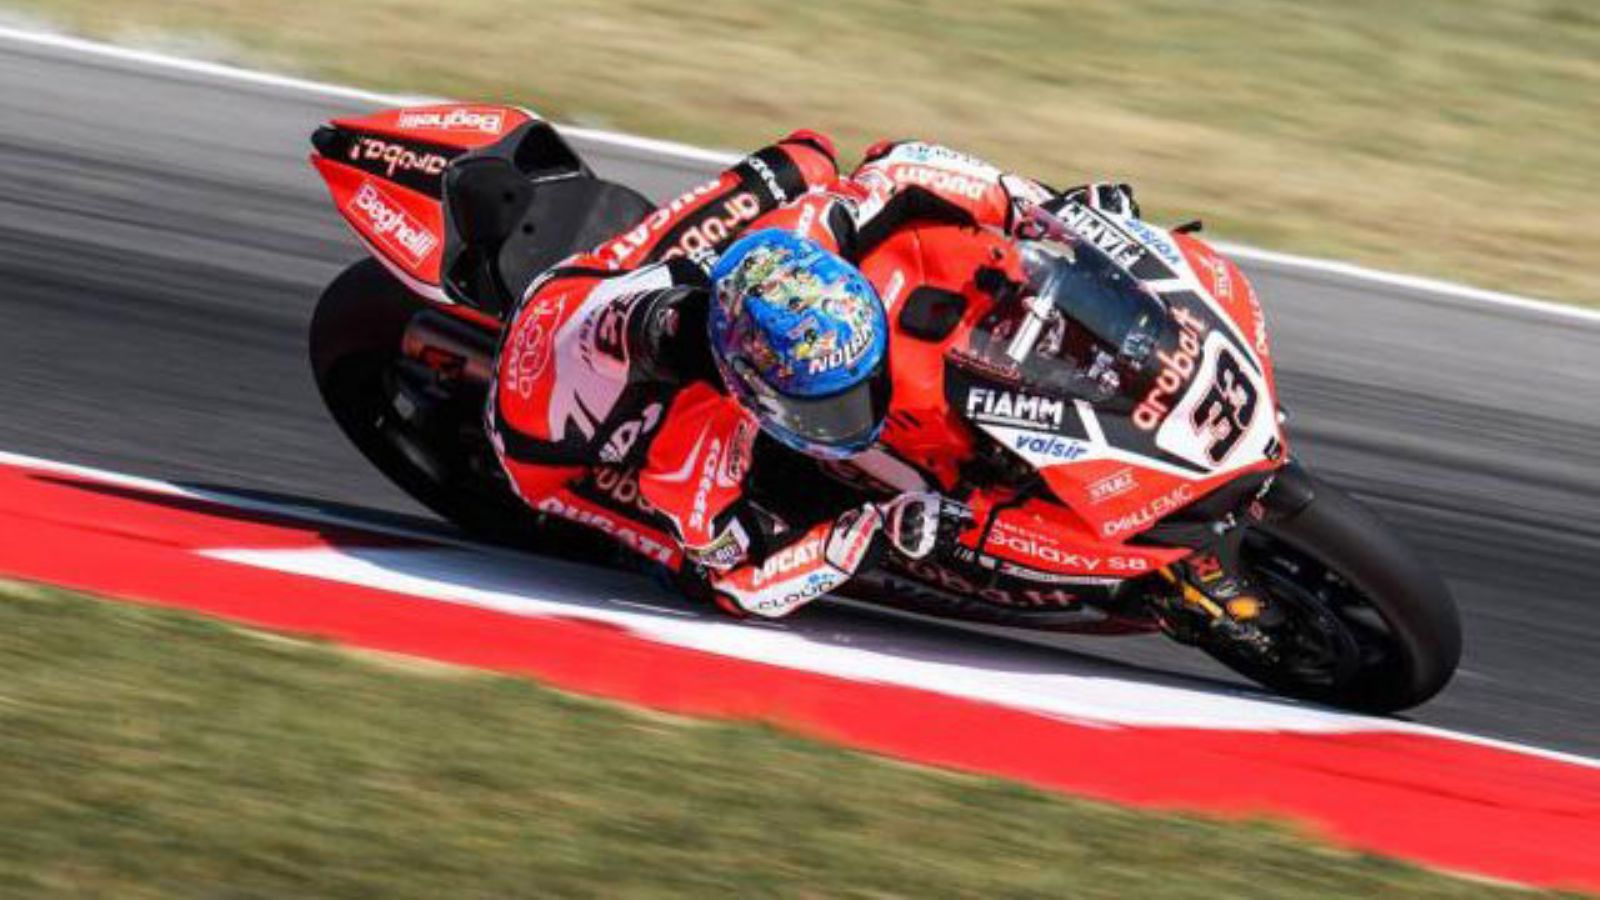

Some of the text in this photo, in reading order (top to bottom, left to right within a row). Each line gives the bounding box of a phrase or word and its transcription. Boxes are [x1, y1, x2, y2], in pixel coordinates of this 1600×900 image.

[355, 184, 438, 261] Beghelli
[966, 387, 1064, 425] FIAMM
[1192, 348, 1258, 464] 33
[1015, 436, 1088, 460] valsir
